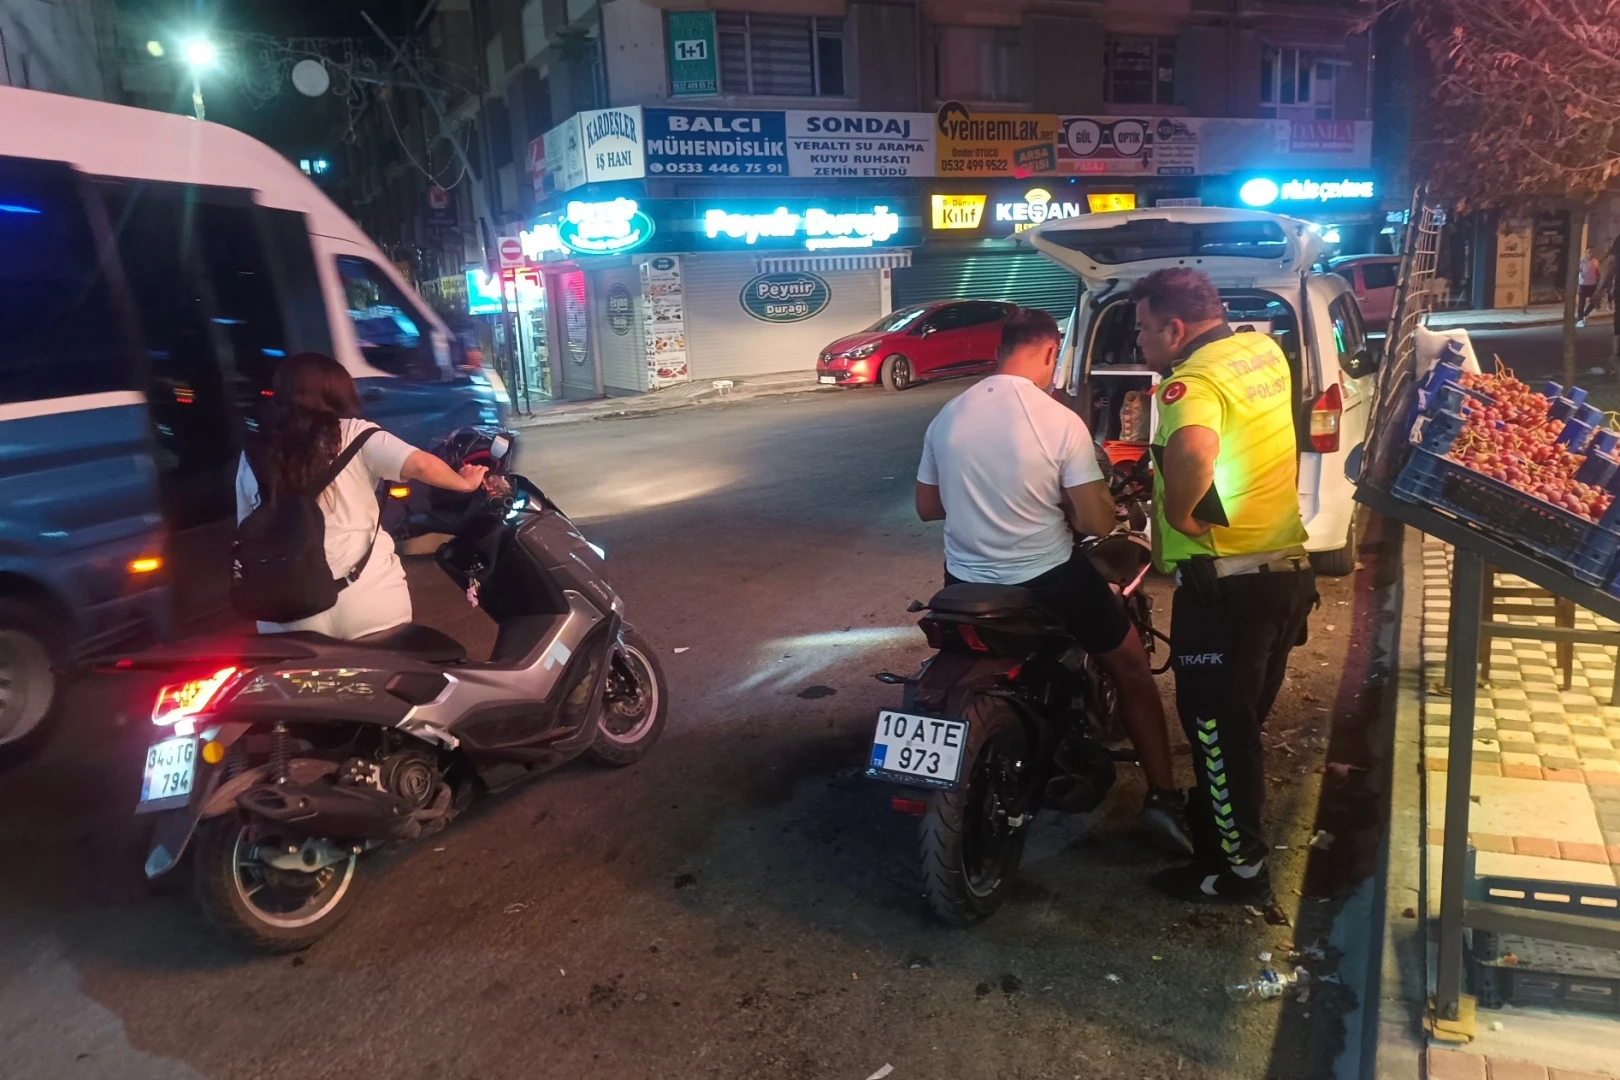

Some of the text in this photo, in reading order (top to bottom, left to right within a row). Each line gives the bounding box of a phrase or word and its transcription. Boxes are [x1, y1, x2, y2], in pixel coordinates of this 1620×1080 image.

[678, 41, 704, 58] 1+1
[586, 112, 637, 149] KARDEŞLER
[668, 116, 761, 132] BALCI
[806, 117, 911, 139] SONDAJ
[1076, 130, 1141, 144] GÜL OPTİK
[647, 136, 784, 156] MÜHENDİSLİK
[794, 141, 925, 152] YERALTI SU ARAMA
[607, 151, 632, 168] HANI
[810, 154, 911, 164] KUYU RUHSATI
[941, 159, 1008, 171] 0532 499 9522
[1075, 161, 1105, 172] PASAJ
[666, 163, 782, 173] 0533 446 75 91
[814, 165, 907, 176] ZEMİN ETÜDÜ
[943, 208, 976, 223] Kılıf
[758, 280, 814, 299] Peynir
[766, 302, 807, 316] Durağı
[884, 715, 961, 748] 10 ATE
[899, 747, 940, 774] 973
[162, 770, 189, 796] 794
